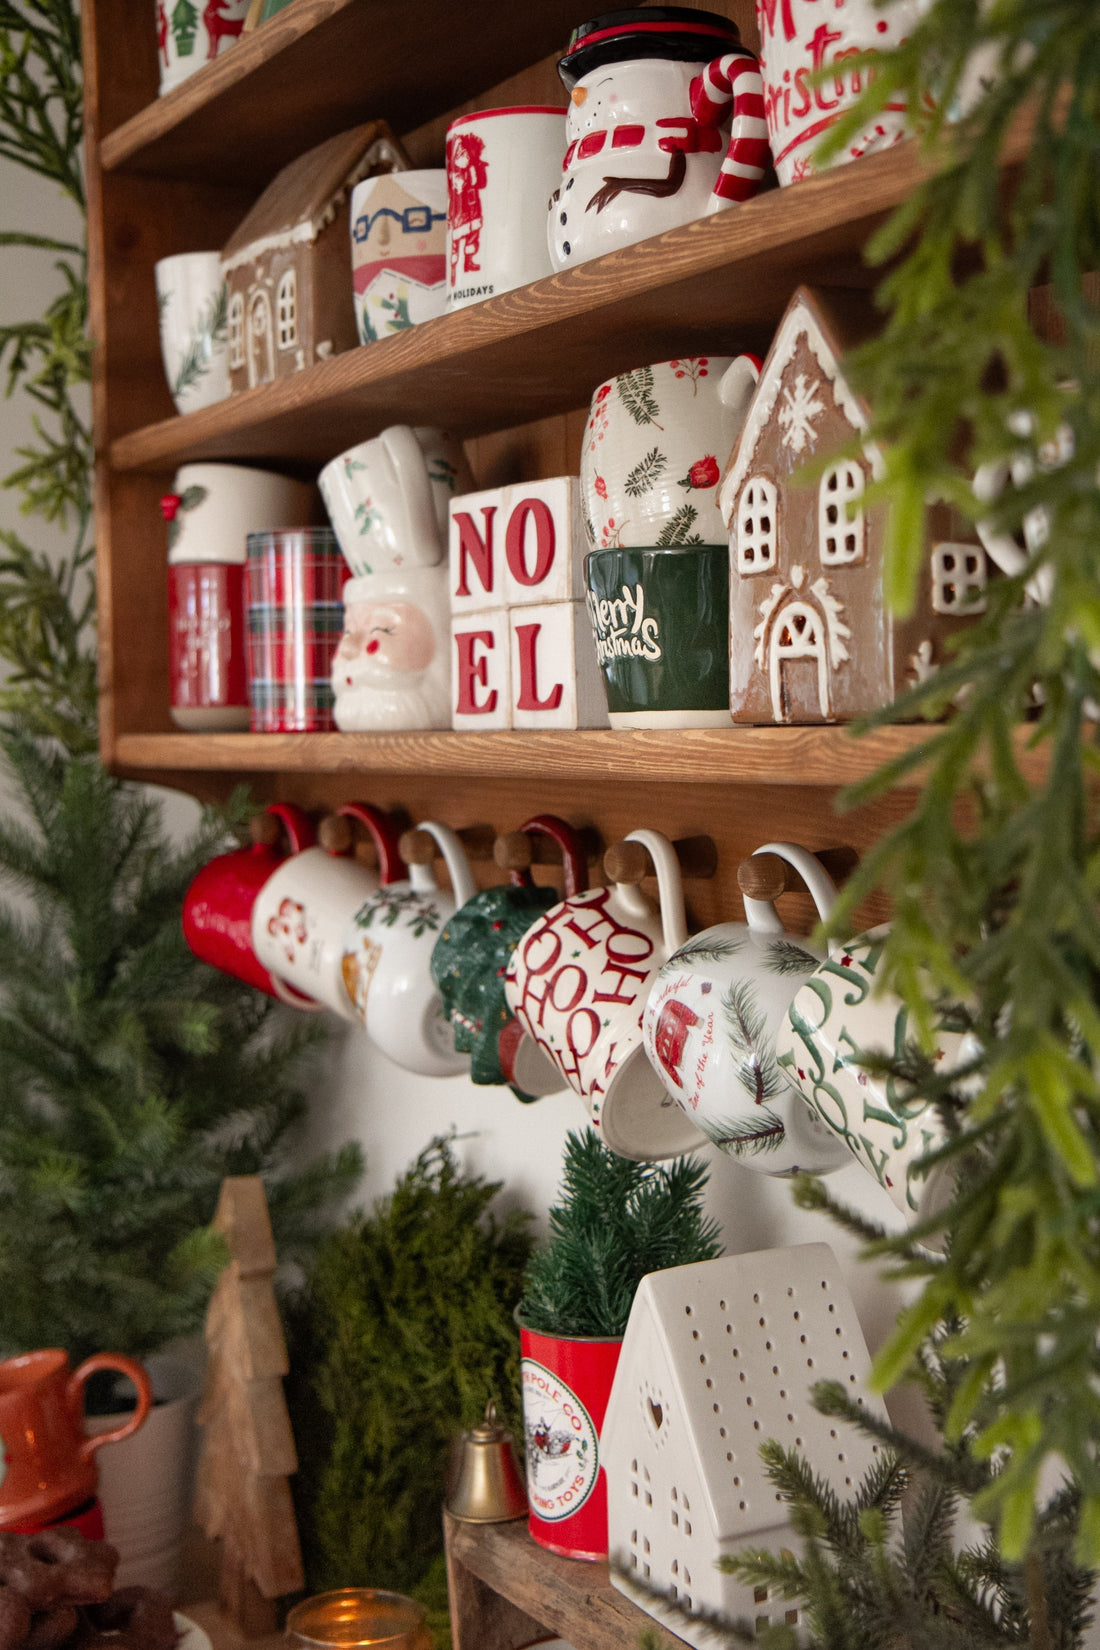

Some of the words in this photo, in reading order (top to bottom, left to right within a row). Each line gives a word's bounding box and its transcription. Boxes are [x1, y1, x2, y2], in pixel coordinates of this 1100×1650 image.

[453, 285, 494, 300] HOLIDAYS
[702, 1011, 714, 1047] Year
[531, 1373, 562, 1404] POLE
[563, 1403, 582, 1431] CO
[558, 1475, 585, 1507] TOYS
